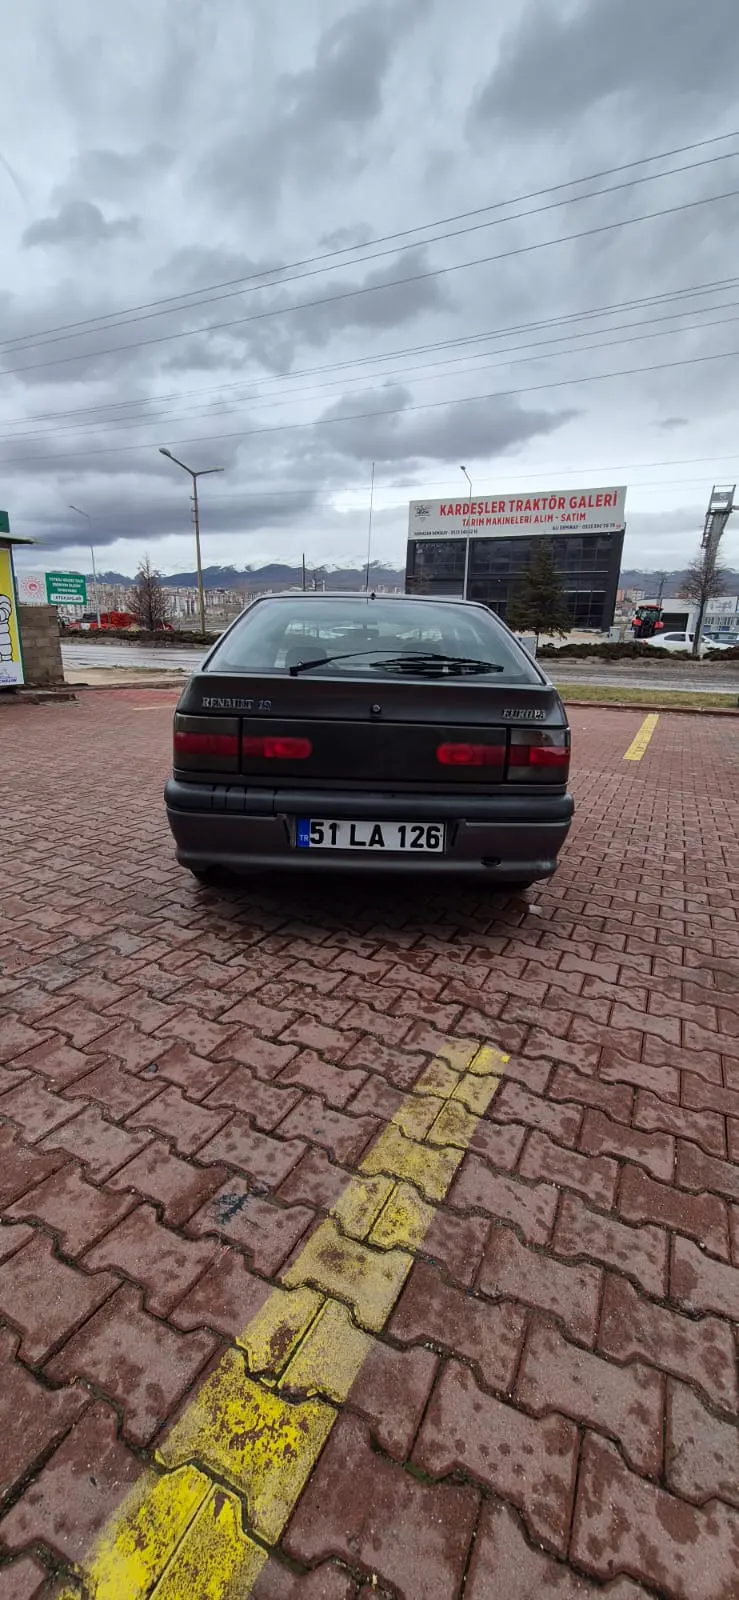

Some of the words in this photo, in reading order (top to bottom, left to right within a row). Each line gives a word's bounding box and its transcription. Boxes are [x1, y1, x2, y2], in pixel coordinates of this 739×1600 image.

[440, 500, 506, 517] KARDEŞLER
[509, 495, 566, 513] TRAKTÖR
[569, 491, 618, 509] GALERİ
[462, 516, 485, 527] TARIM
[534, 513, 554, 523] ALIM
[560, 512, 587, 522] SATIM
[203, 697, 254, 709] RENAULT
[299, 834, 309, 842] TR
[310, 821, 338, 845] 51
[350, 824, 385, 847] LA
[397, 825, 441, 849] 126
